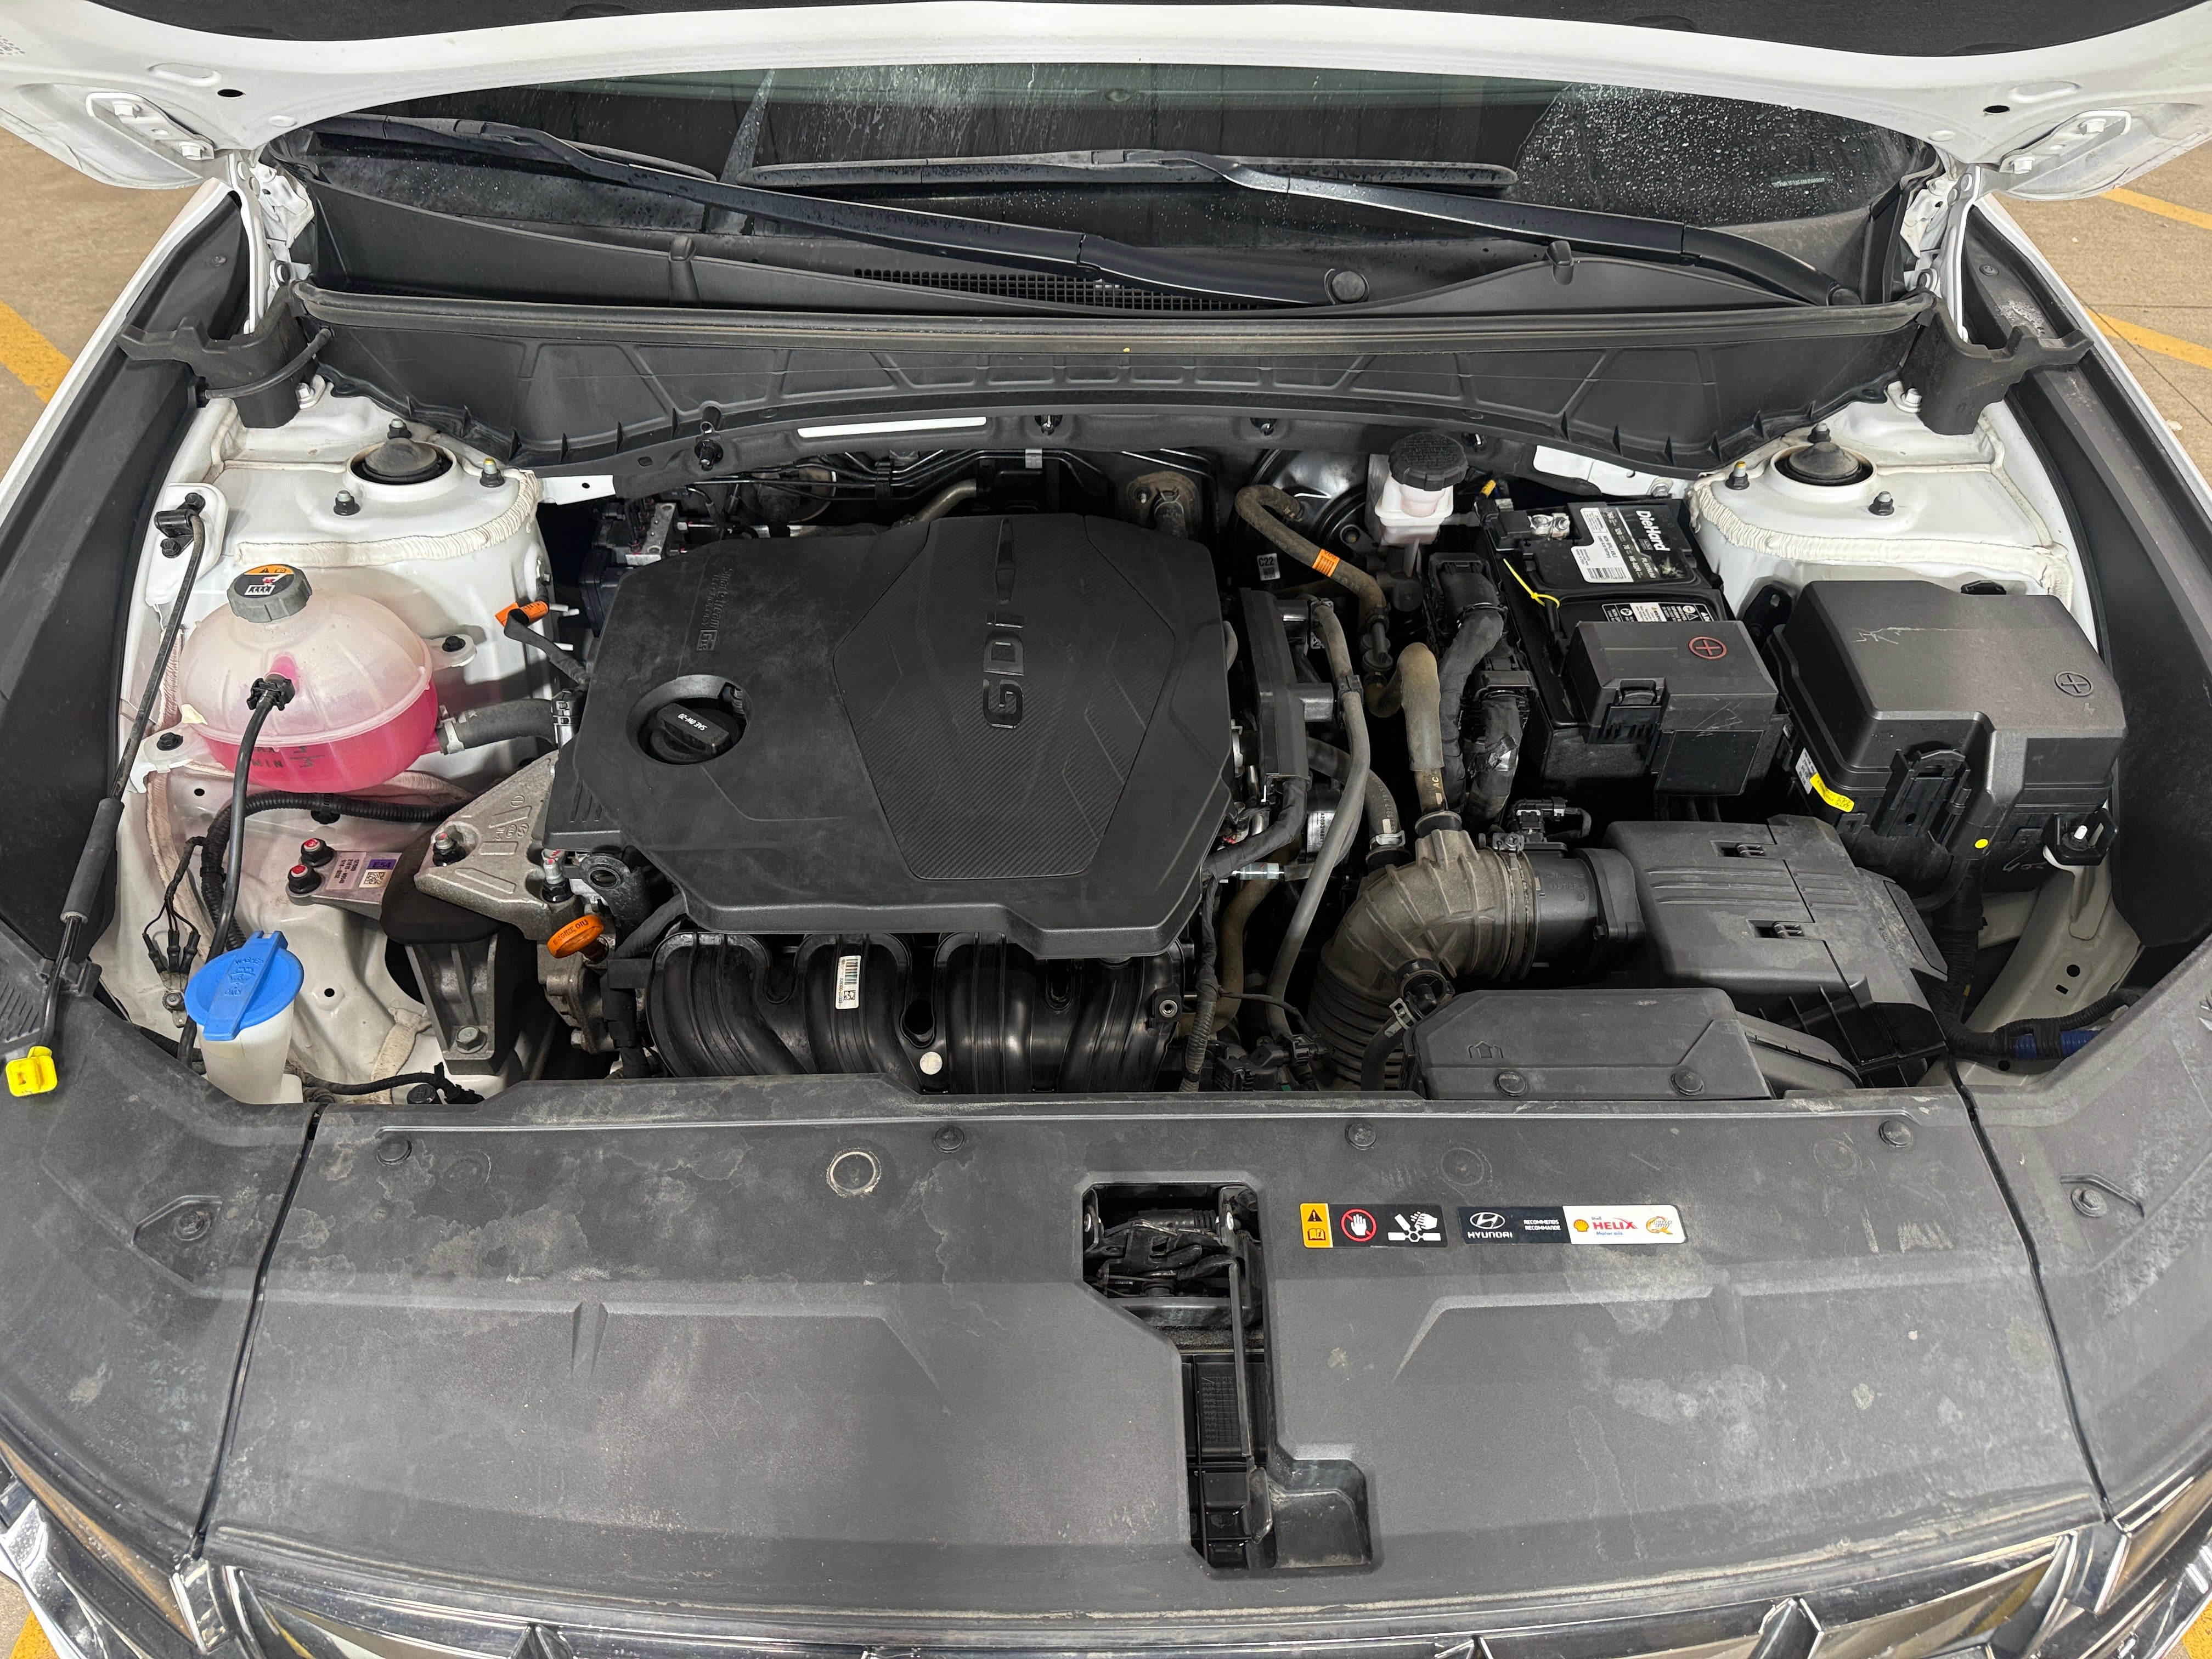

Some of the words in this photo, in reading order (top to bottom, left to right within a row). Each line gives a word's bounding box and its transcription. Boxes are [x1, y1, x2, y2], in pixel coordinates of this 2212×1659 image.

[1636, 510, 1671, 551] DieHard
[1259, 557, 1274, 567] C22
[251, 759, 283, 768] MIN
[1432, 776, 1441, 788] AC
[552, 926, 575, 945] ENGINE
[575, 919, 589, 929] OIL
[1593, 1221, 1637, 1229] HELIX
